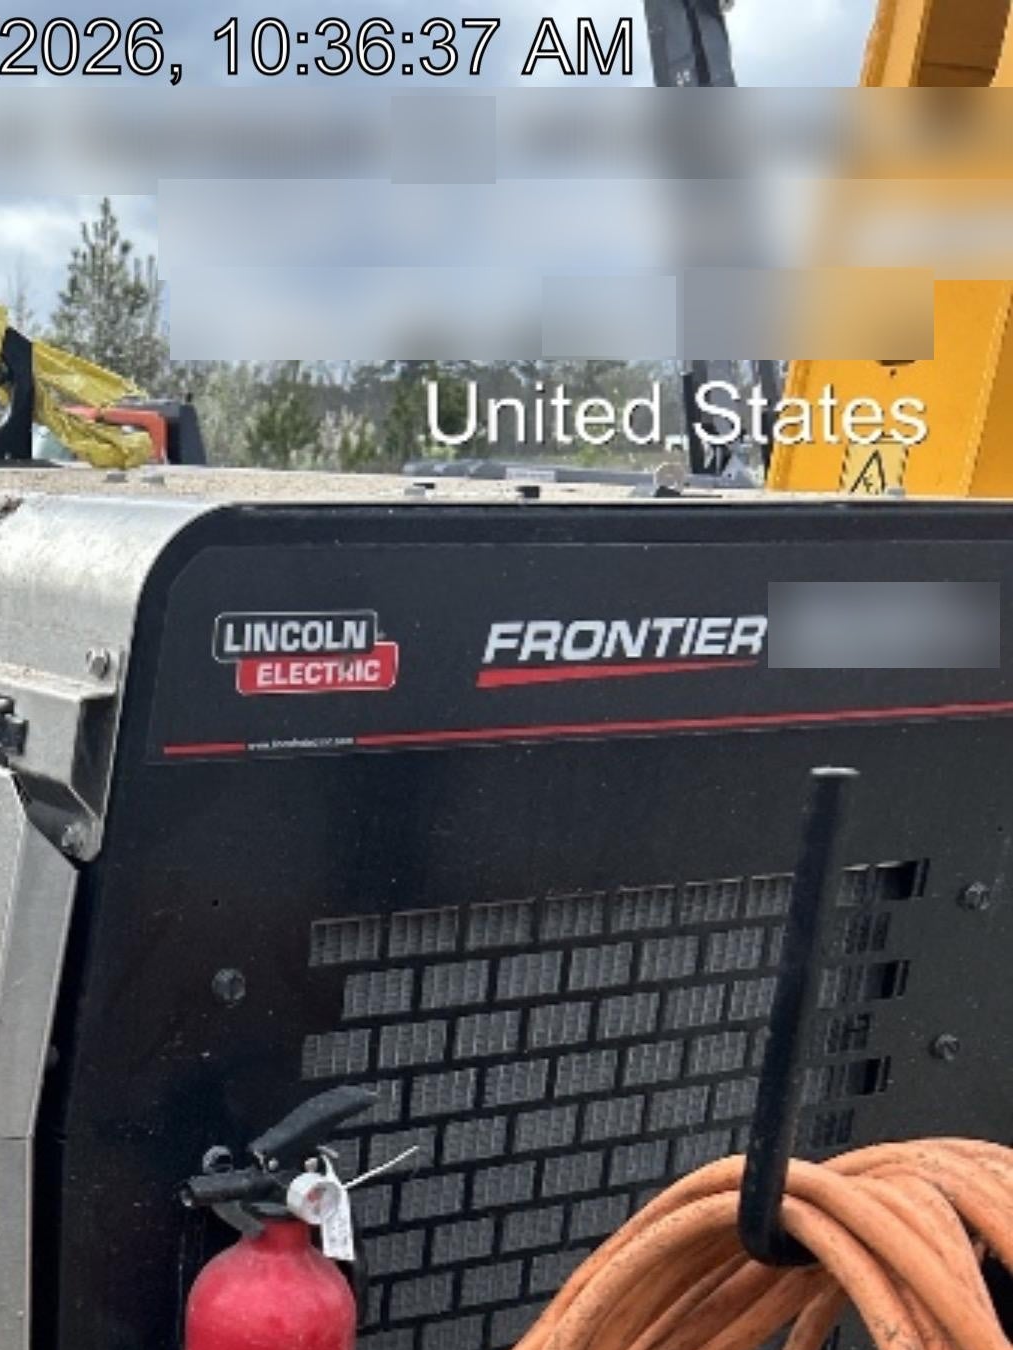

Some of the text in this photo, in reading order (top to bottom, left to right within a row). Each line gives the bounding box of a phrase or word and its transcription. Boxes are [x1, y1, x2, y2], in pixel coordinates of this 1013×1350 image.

[223, 620, 368, 653] LINCOLN
[481, 614, 769, 665] FRONTIER
[255, 658, 382, 688] ELECTRIC
